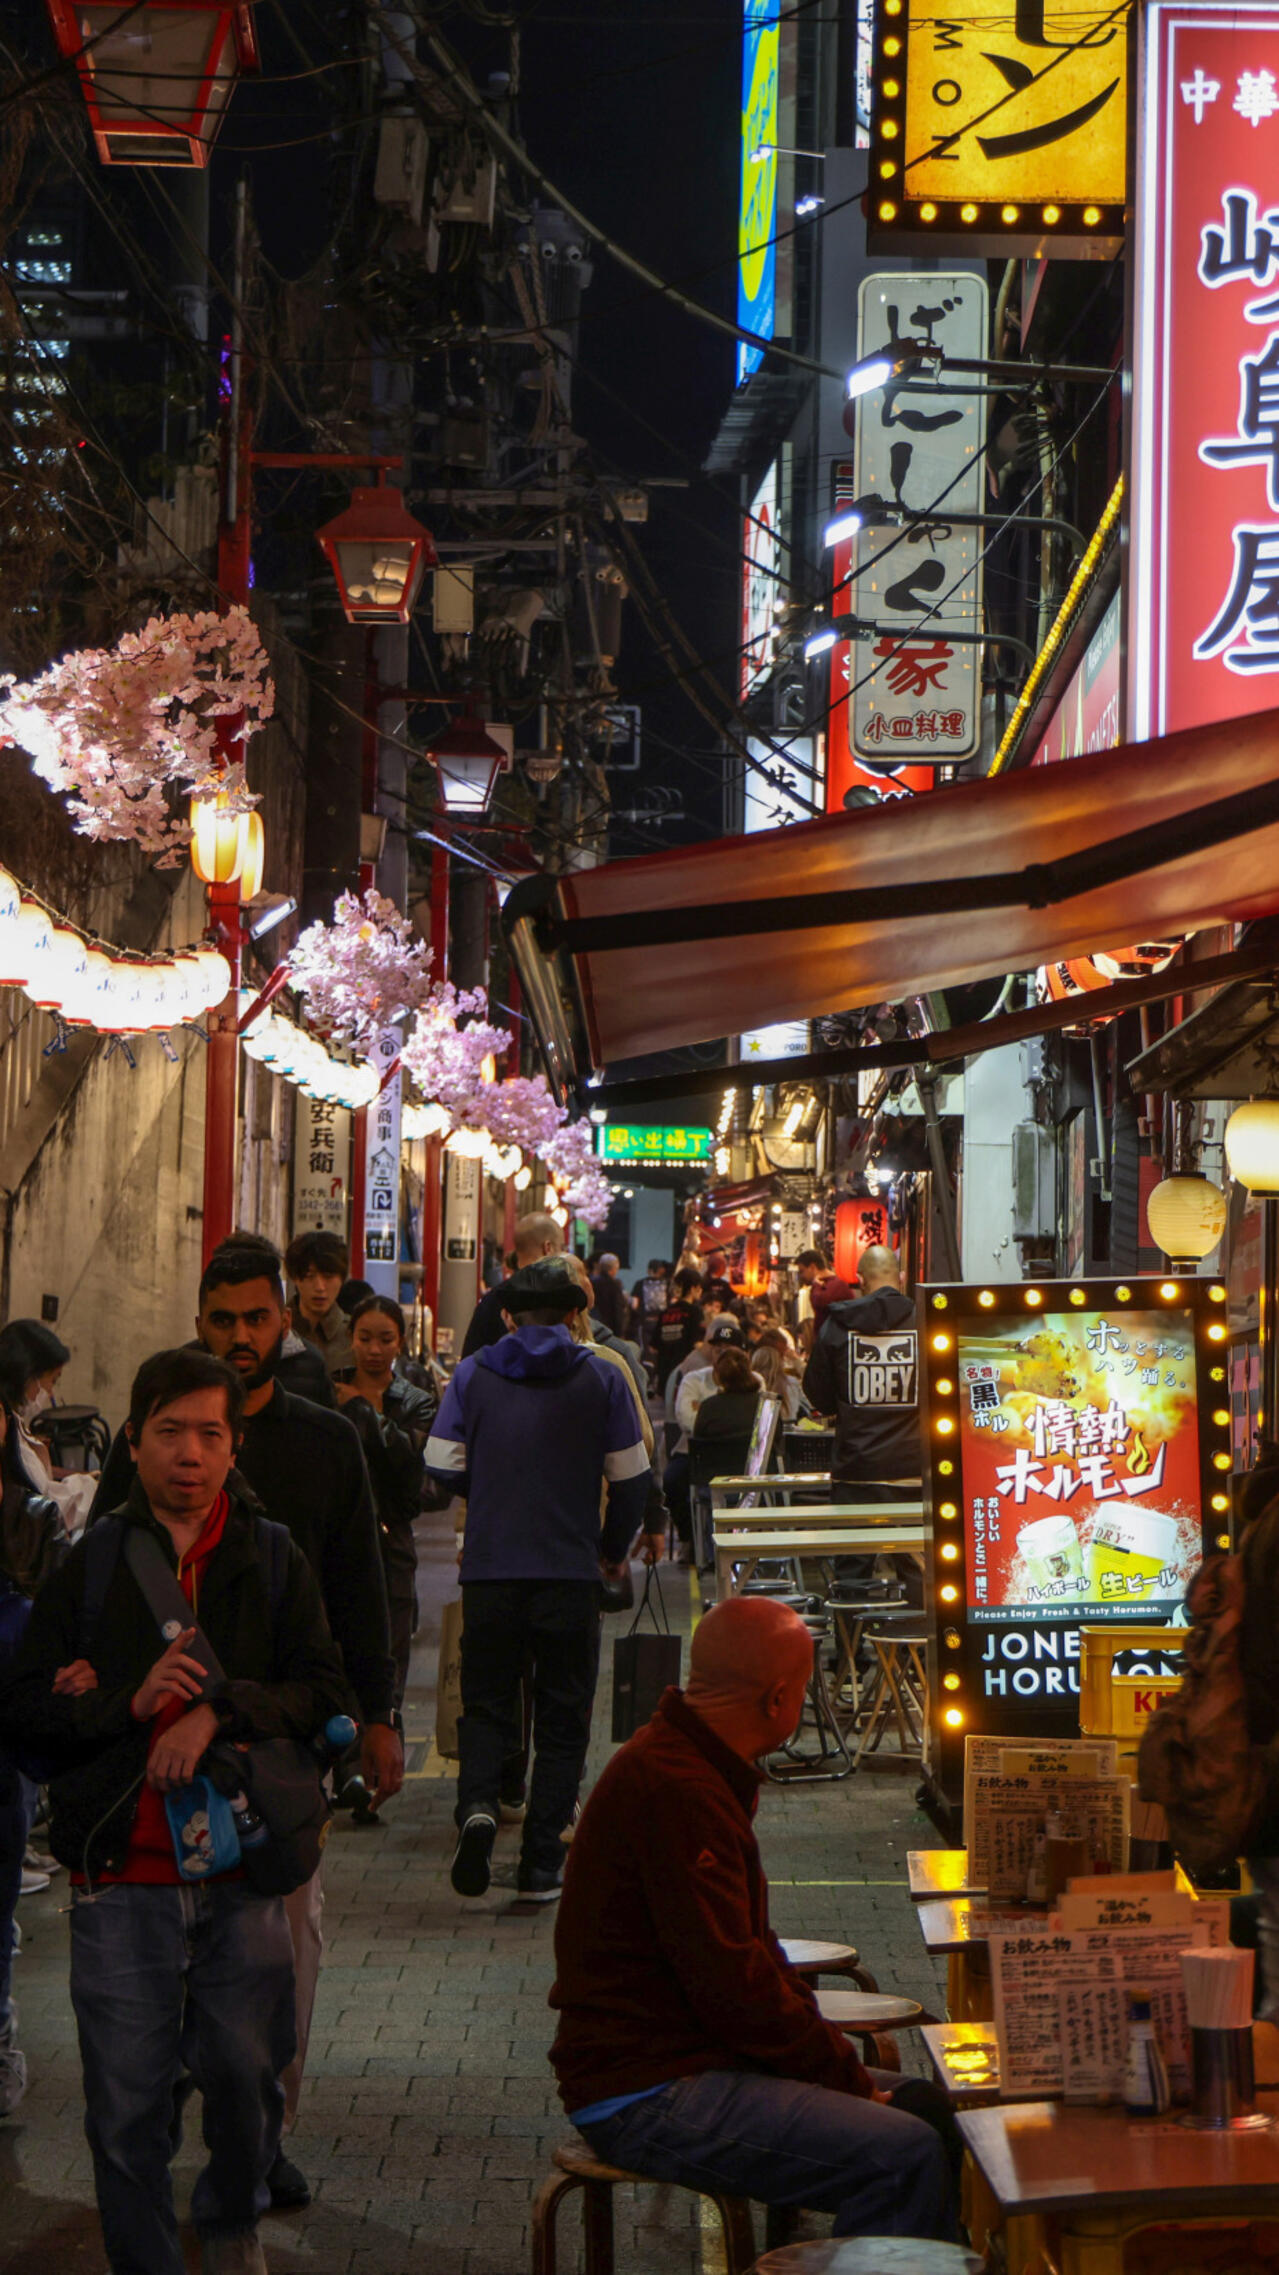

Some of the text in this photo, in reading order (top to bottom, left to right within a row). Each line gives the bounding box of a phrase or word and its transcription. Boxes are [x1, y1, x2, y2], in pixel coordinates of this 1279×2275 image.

[865, 710, 965, 743] 小皿料理
[607, 1128, 706, 1153] 思い出横丁
[1086, 1319, 1185, 1361] ホッとする
[854, 1365, 914, 1404] OBEY
[970, 1381, 1000, 1411] 黒
[973, 1411, 1009, 1433] ホル
[1023, 1399, 1131, 1458] 情熱
[995, 1441, 1167, 1504] ホルモン
[986, 1496, 1001, 1542] おいしい
[1026, 1576, 1091, 1601] ハイボール
[1100, 1568, 1178, 1599] 生ビール
[974, 1610, 1007, 1620] Please
[1010, 1609, 1037, 1620] Enjoy
[1042, 1607, 1070, 1617] Fresh
[1073, 1607, 1081, 1616] &
[1083, 1606, 1110, 1617] Tasty
[977, 1777, 1029, 1789] お飲み物
[1001, 1937, 1072, 1954] お飲み物
